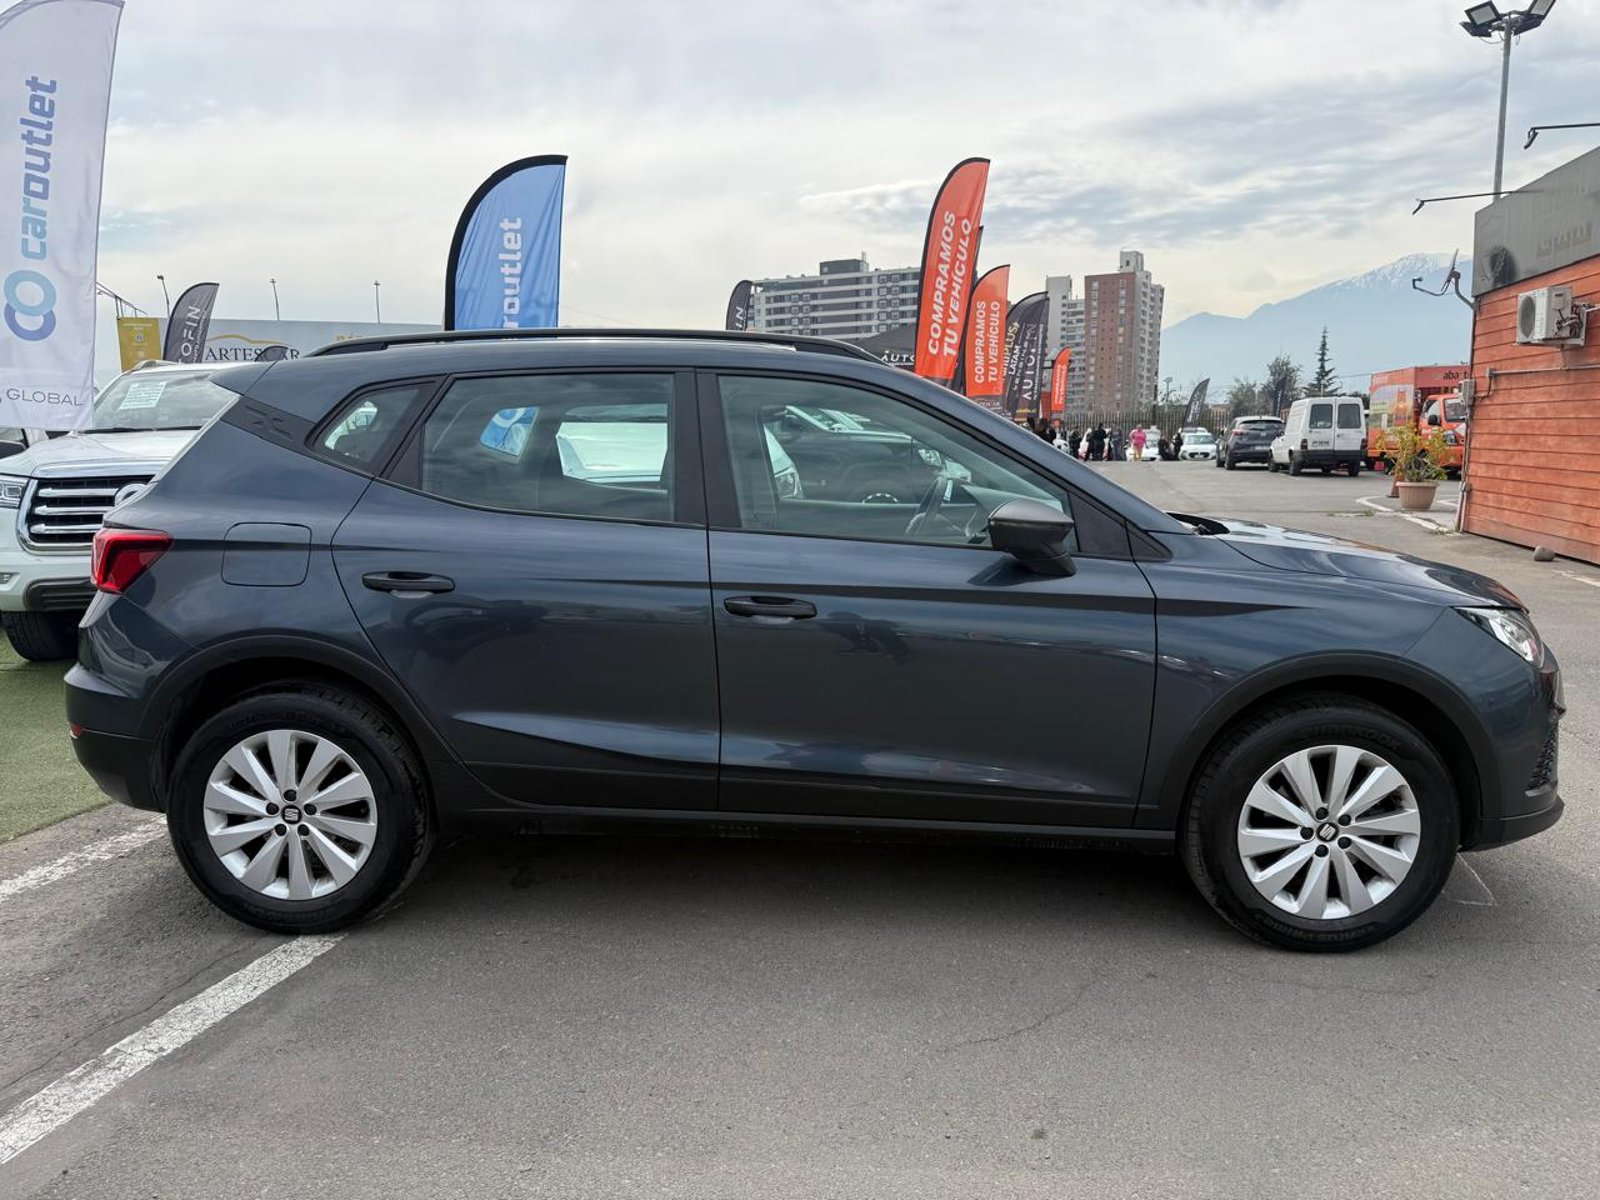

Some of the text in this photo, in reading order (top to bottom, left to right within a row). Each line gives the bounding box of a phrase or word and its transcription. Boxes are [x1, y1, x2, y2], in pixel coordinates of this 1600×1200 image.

[20, 75, 57, 260] caroutlet
[928, 210, 956, 355] COMPRAMOS
[943, 328, 958, 356] TU
[974, 301, 986, 383] COMPRAMOS
[988, 367, 998, 382] TU
[1008, 345, 1021, 376] LATAM
[6, 388, 85, 406] GLOBAL
